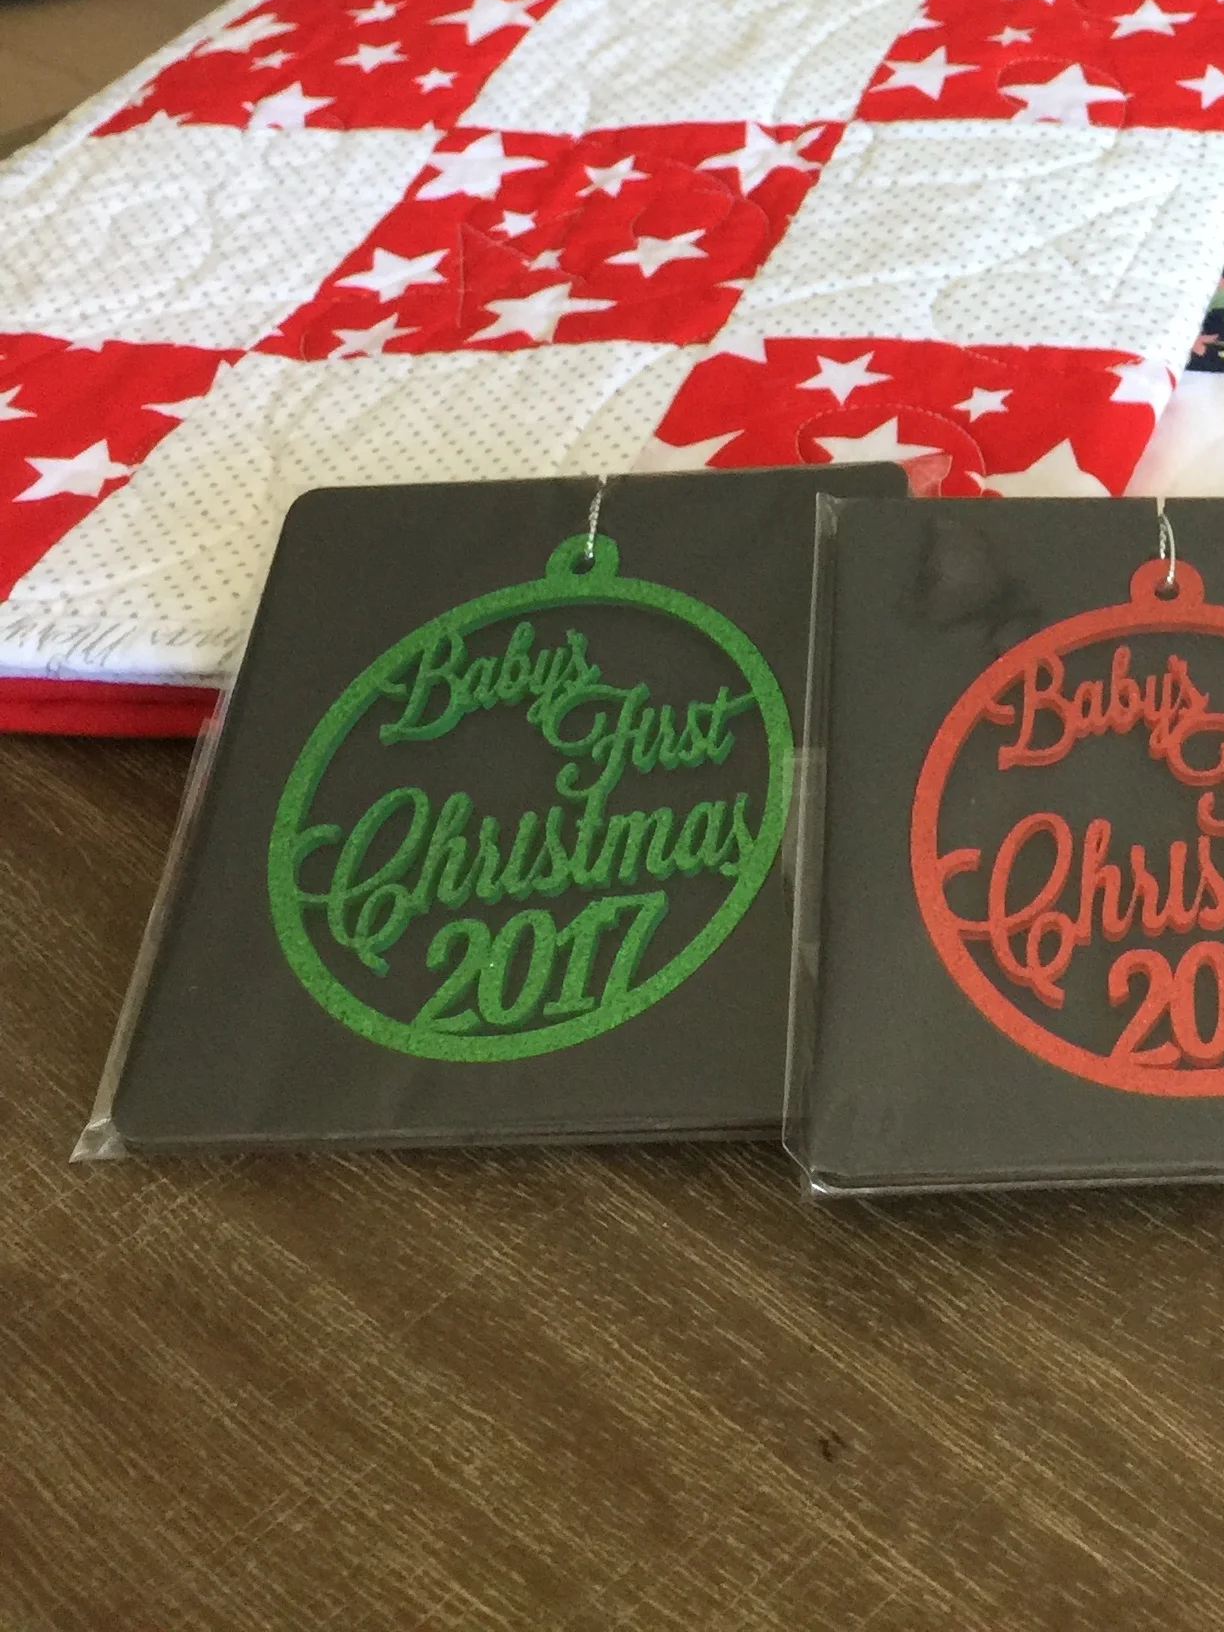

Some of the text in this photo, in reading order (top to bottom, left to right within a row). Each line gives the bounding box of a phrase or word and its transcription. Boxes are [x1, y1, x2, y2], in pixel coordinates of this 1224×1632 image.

[541, 683, 752, 799] First
[299, 787, 755, 975] Christmas
[412, 891, 668, 1034] 2017
